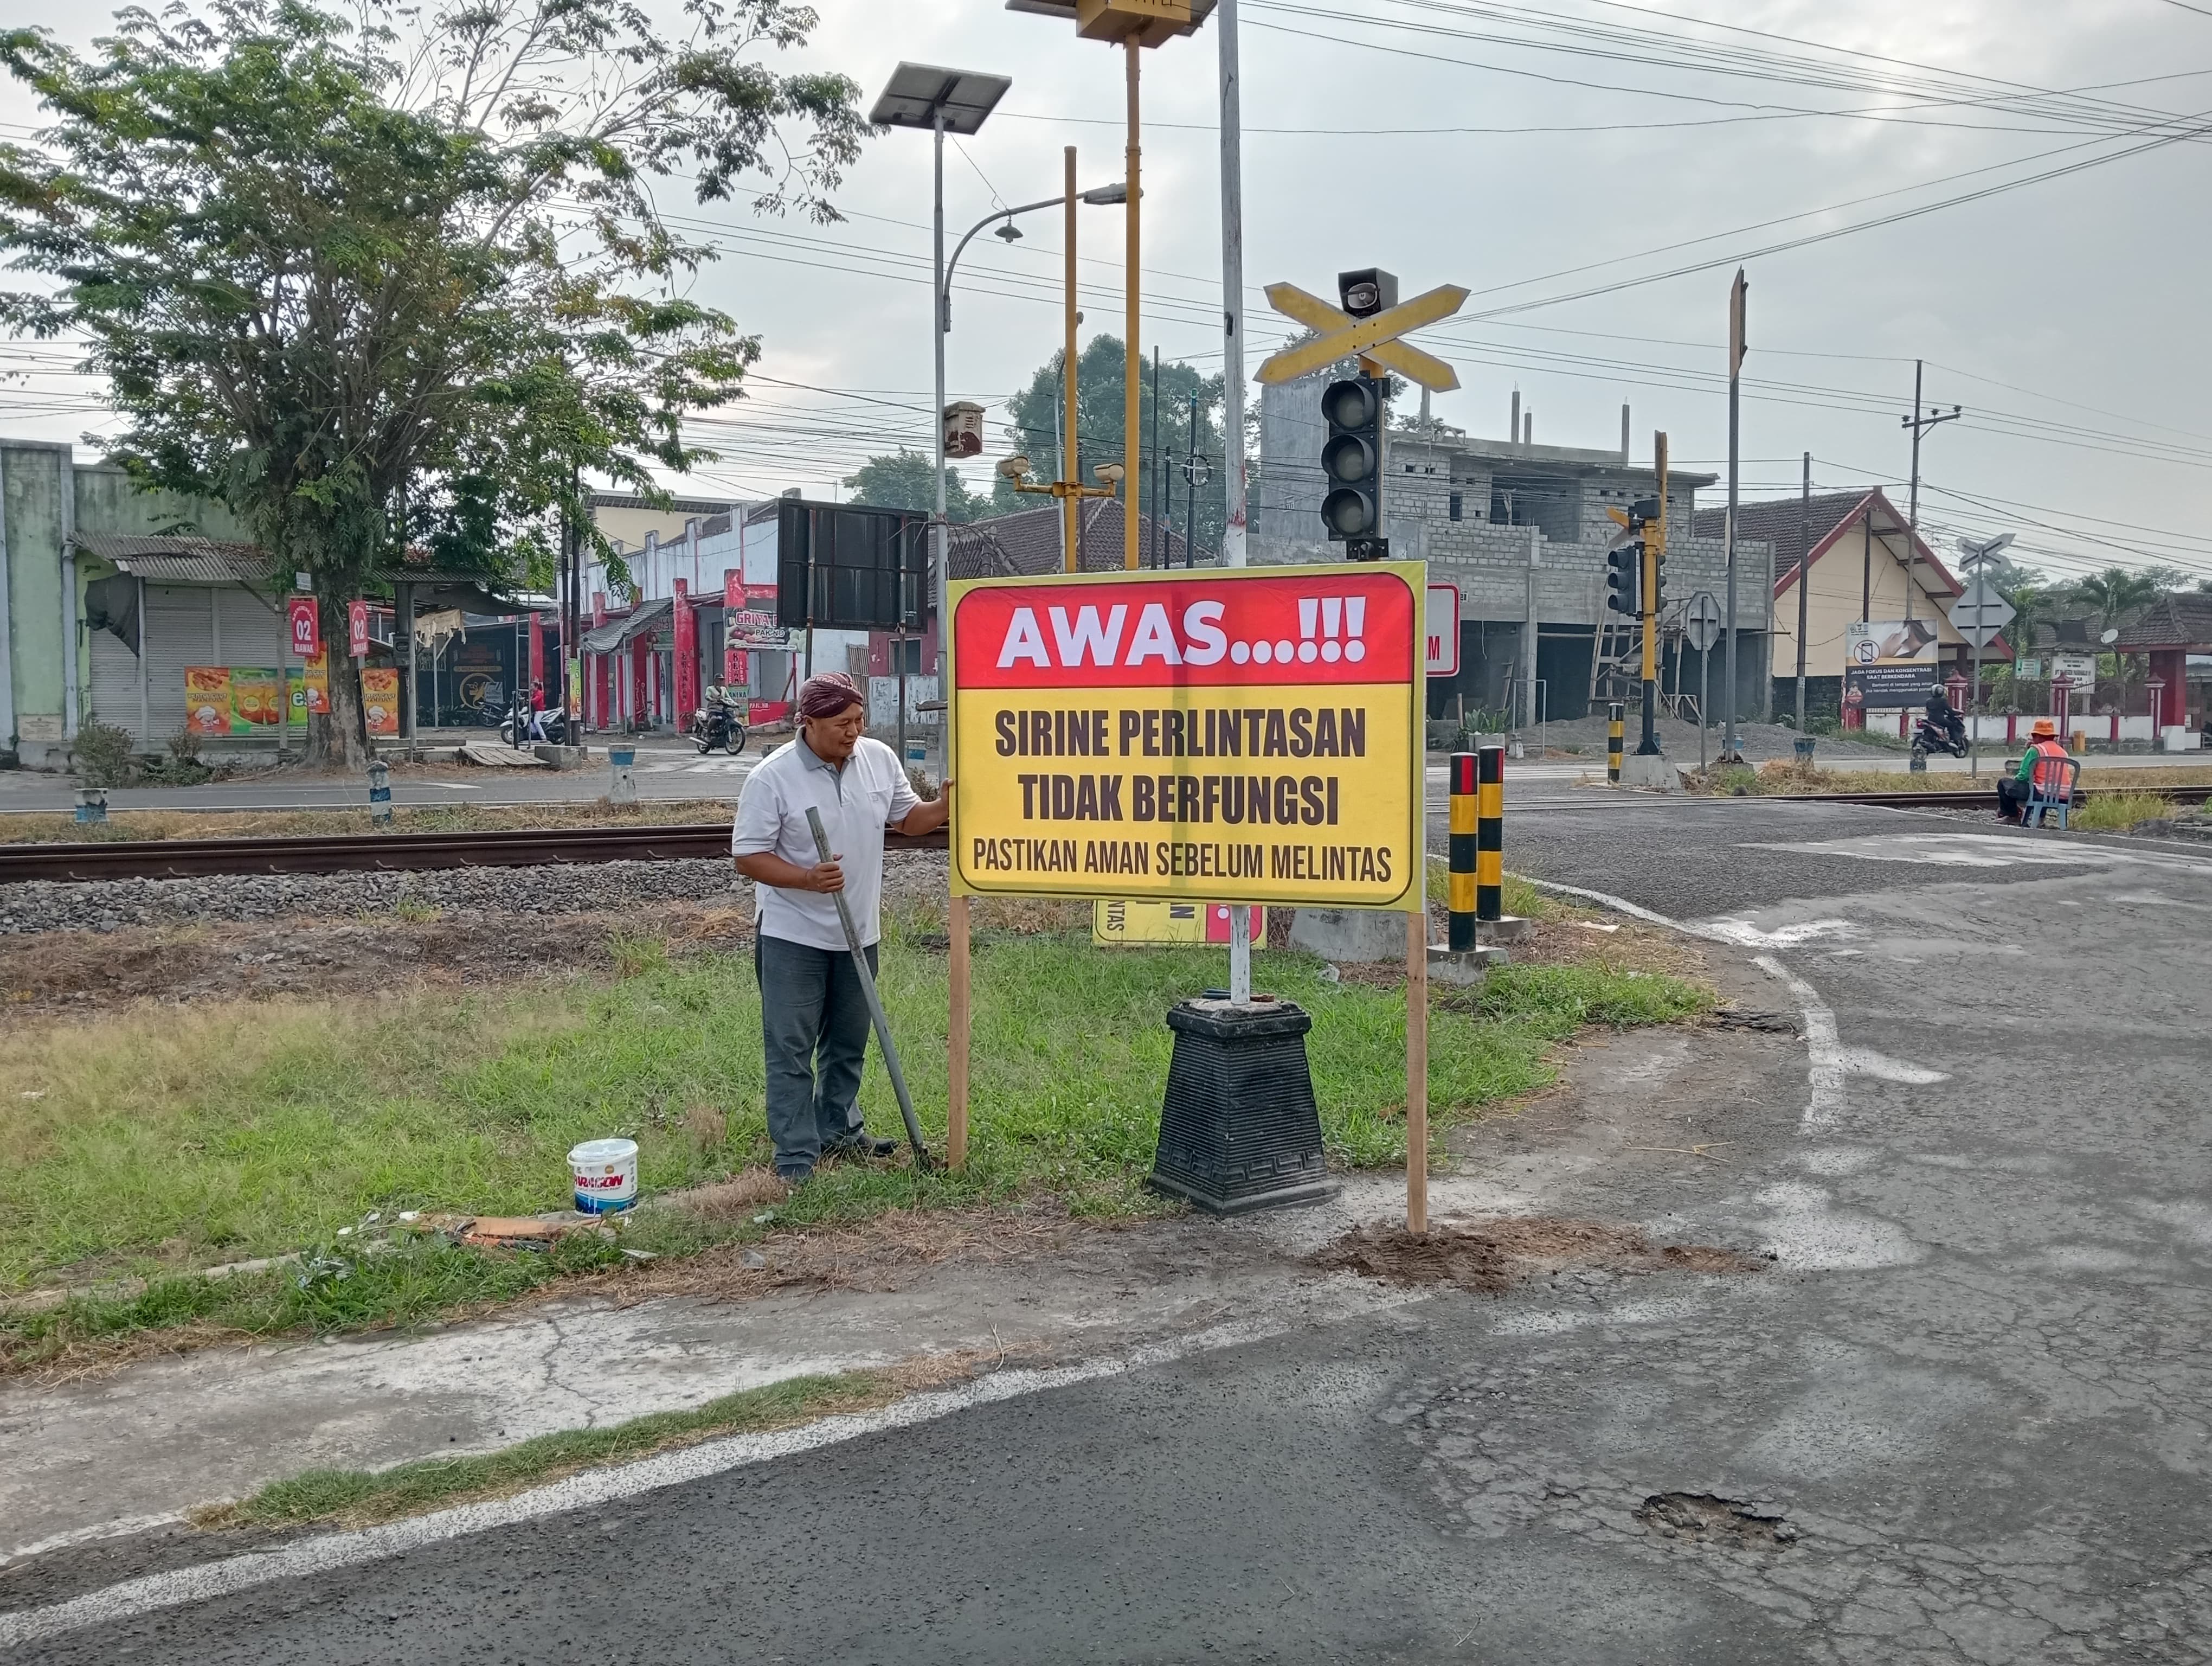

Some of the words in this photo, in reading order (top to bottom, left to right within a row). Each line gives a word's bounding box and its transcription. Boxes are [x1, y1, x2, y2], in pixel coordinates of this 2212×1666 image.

[296, 620, 311, 640] 02
[354, 619, 365, 640] 02
[996, 710, 1109, 757] SIRINE
[1119, 708, 1365, 757] PERLINTASAN
[1018, 774, 1123, 821] TIDAK
[1133, 776, 1338, 825] BERFUNGSI
[974, 838, 1077, 872] PASTIKAN
[1084, 841, 1148, 874] AMAN
[1156, 842, 1263, 877] SEBELUM
[1271, 845, 1391, 882] MELINTAS
